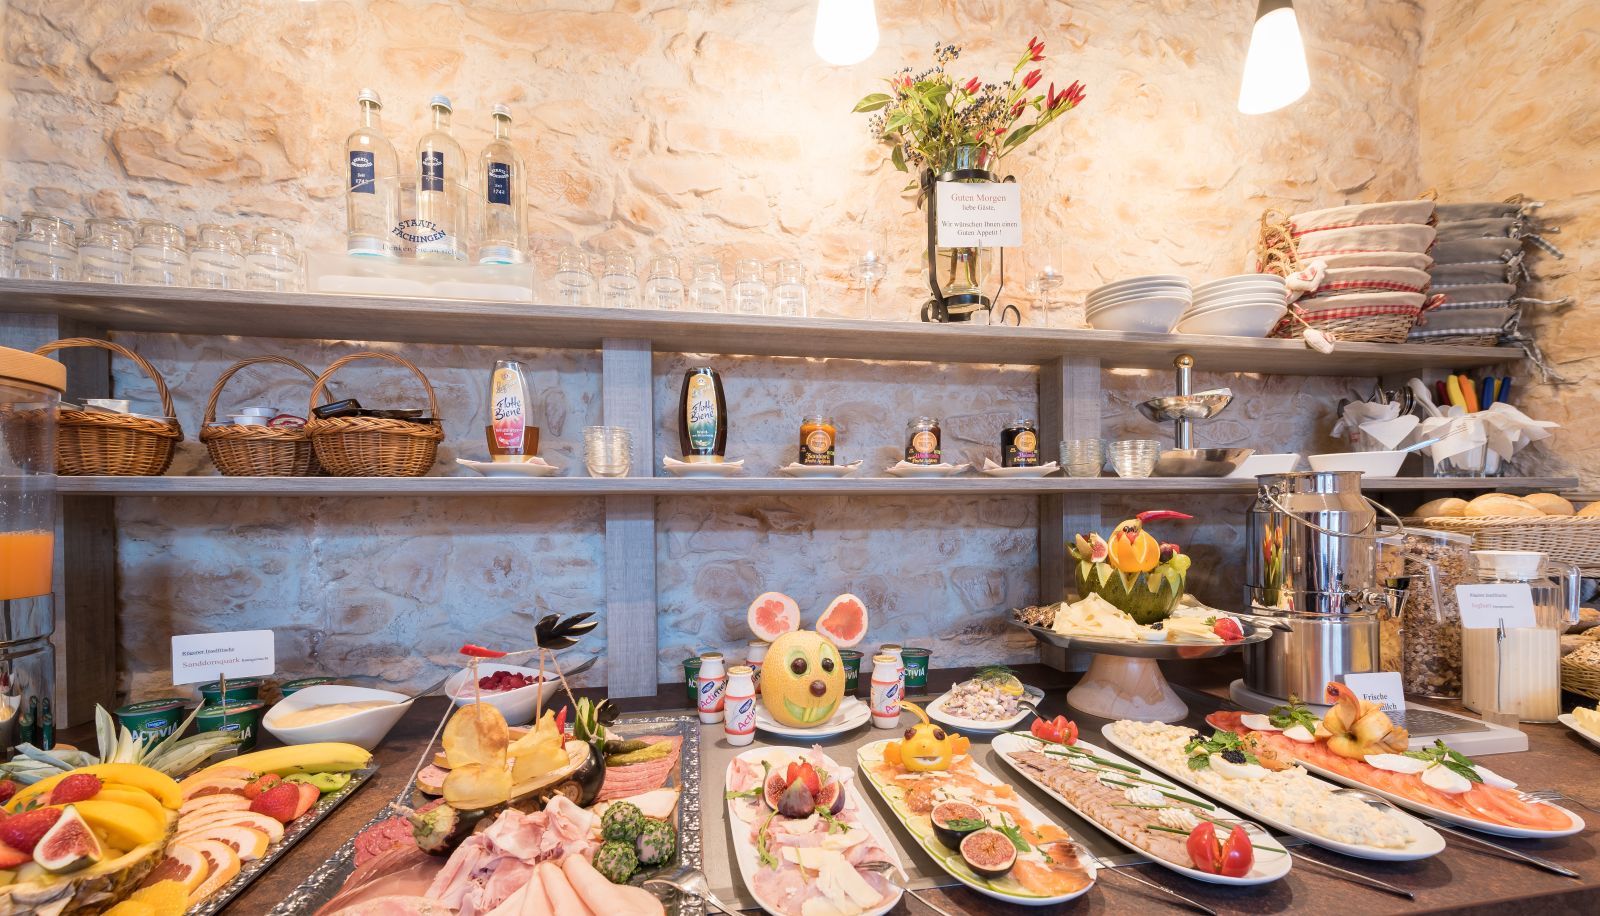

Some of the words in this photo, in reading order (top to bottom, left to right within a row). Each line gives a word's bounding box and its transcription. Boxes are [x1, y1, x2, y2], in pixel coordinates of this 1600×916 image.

[951, 193, 974, 202] Guten
[976, 194, 1006, 203] Morgen
[392, 226, 446, 243] FACHINGEN
[976, 229, 998, 237] Appetit
[496, 396, 521, 408] Flotte
[495, 408, 521, 421] Biene
[690, 411, 714, 423] Biene
[904, 666, 925, 678] CTIVIA
[700, 680, 726, 708] Actimel
[1363, 692, 1388, 701] Frische
